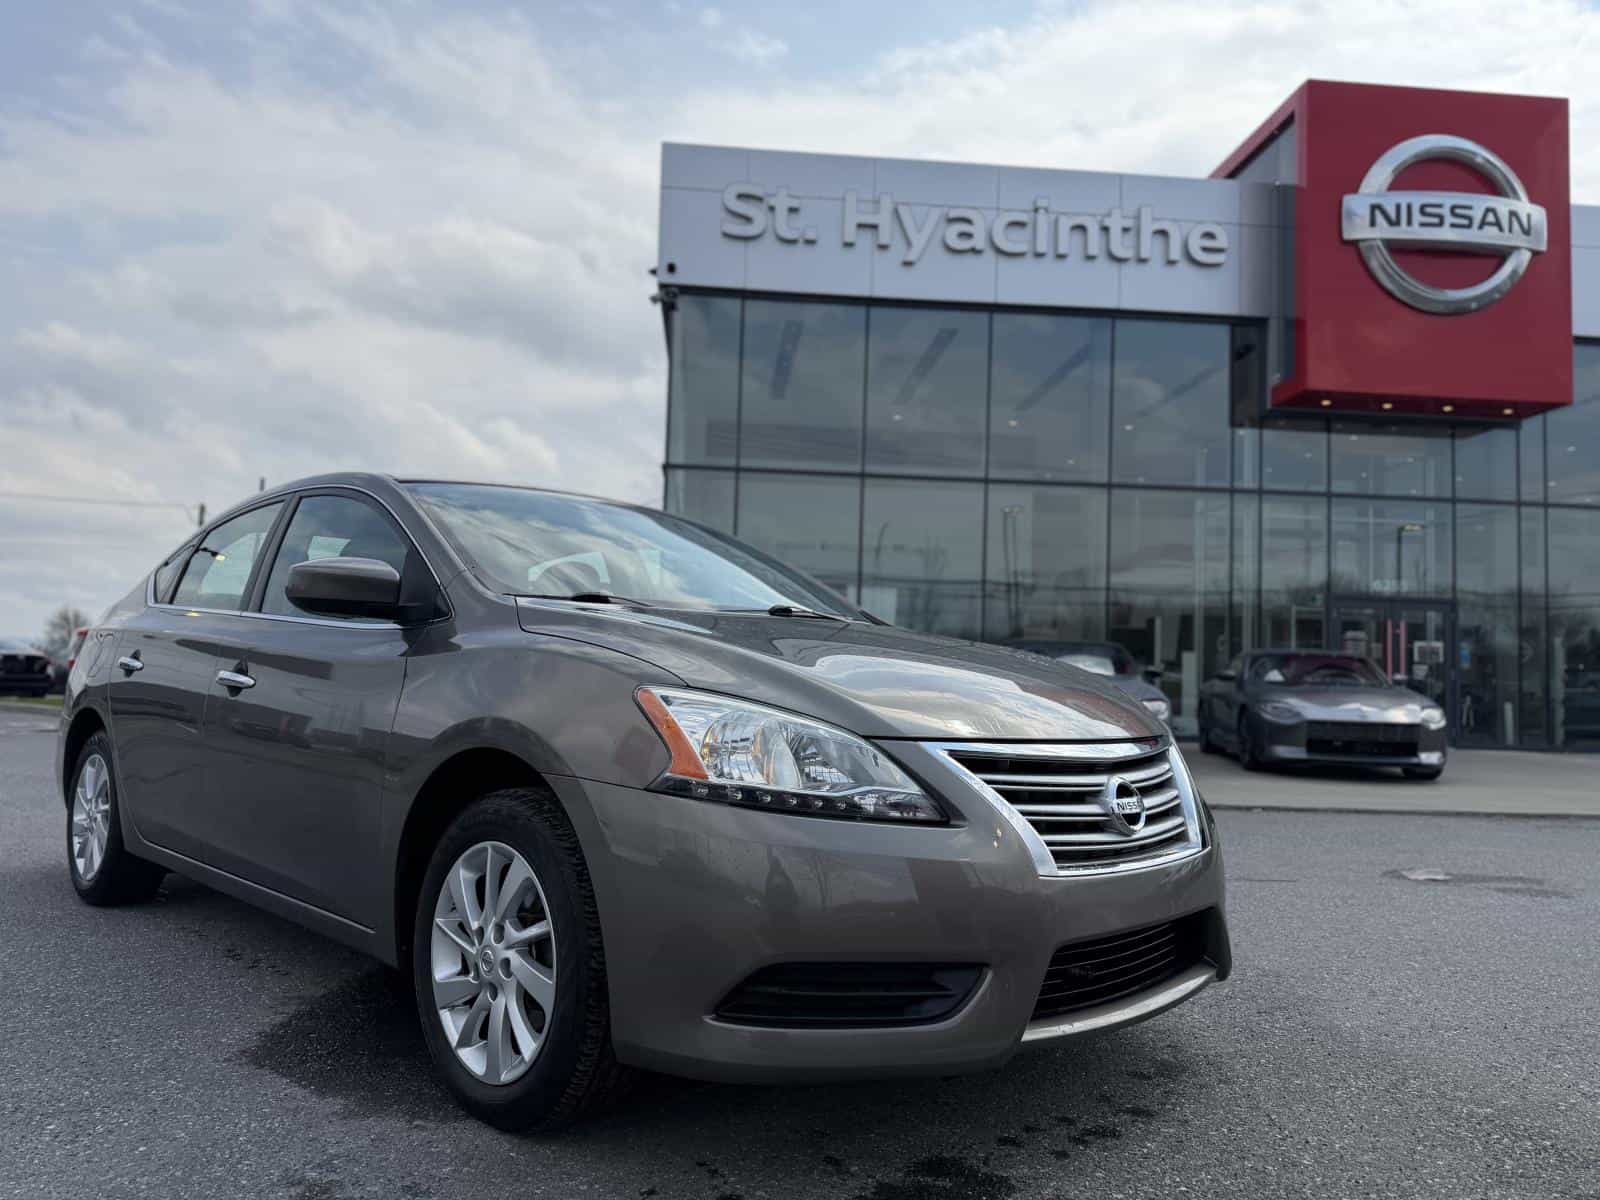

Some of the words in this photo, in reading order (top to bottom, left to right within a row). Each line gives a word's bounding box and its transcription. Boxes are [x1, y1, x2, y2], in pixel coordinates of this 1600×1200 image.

[721, 184, 817, 244] St.
[840, 188, 1229, 266] Hyacinthe
[1369, 203, 1533, 237] NISSAN
[1116, 801, 1138, 811] NISS
